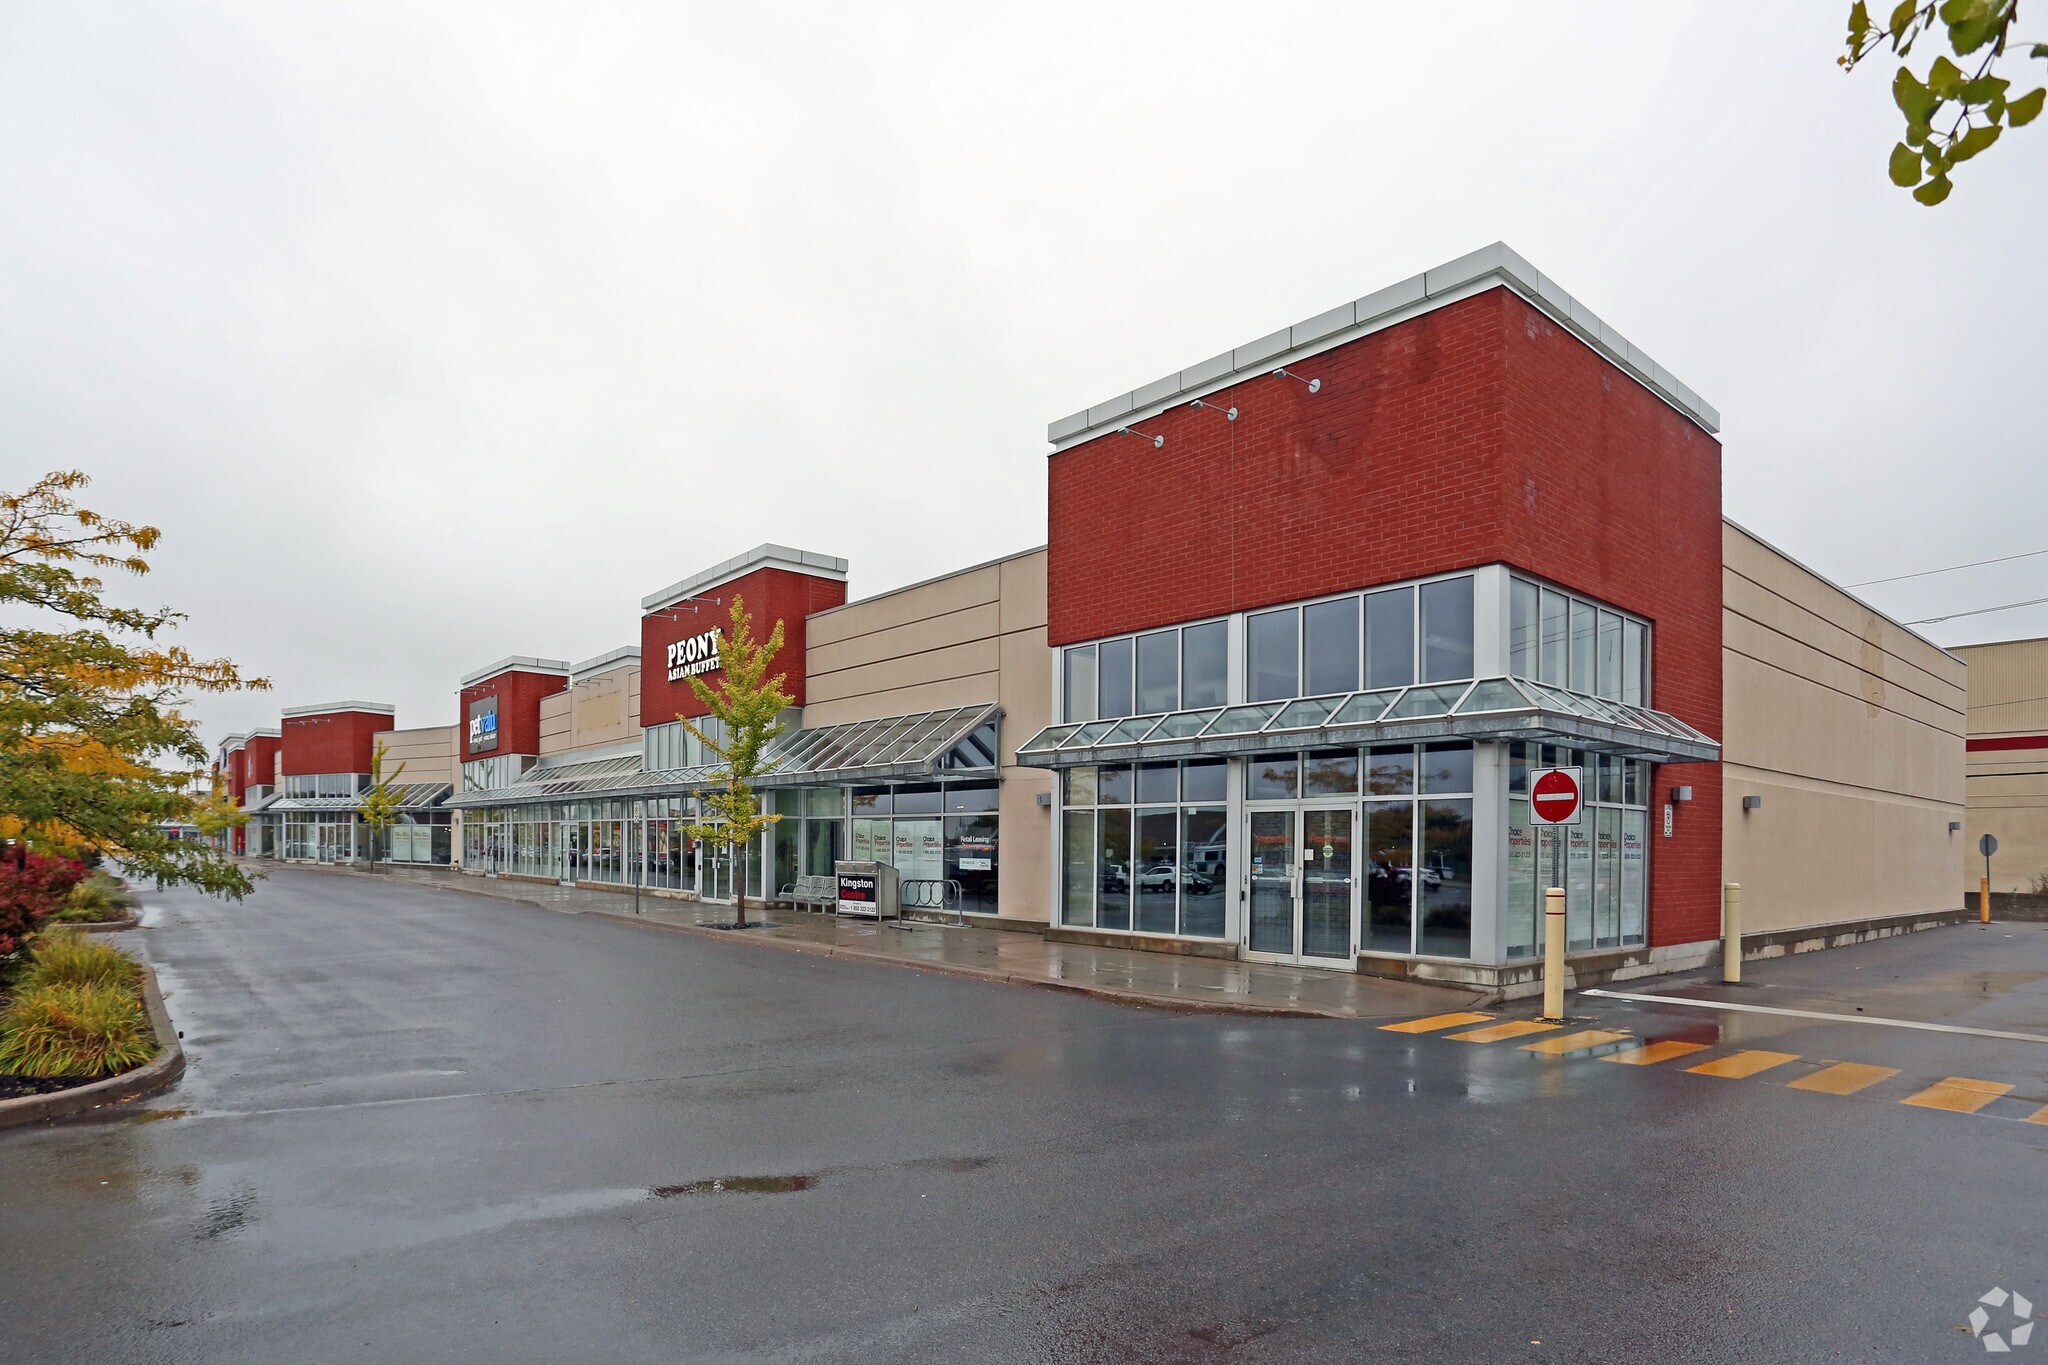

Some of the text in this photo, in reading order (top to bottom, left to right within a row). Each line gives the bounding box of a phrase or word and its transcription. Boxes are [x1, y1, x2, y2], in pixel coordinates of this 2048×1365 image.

[667, 628, 721, 668] PEONY
[668, 656, 720, 681] ASIAN BUFFET
[973, 836, 989, 844] Leasing
[840, 878, 874, 889] Kingston
[841, 889, 866, 899] Centre
